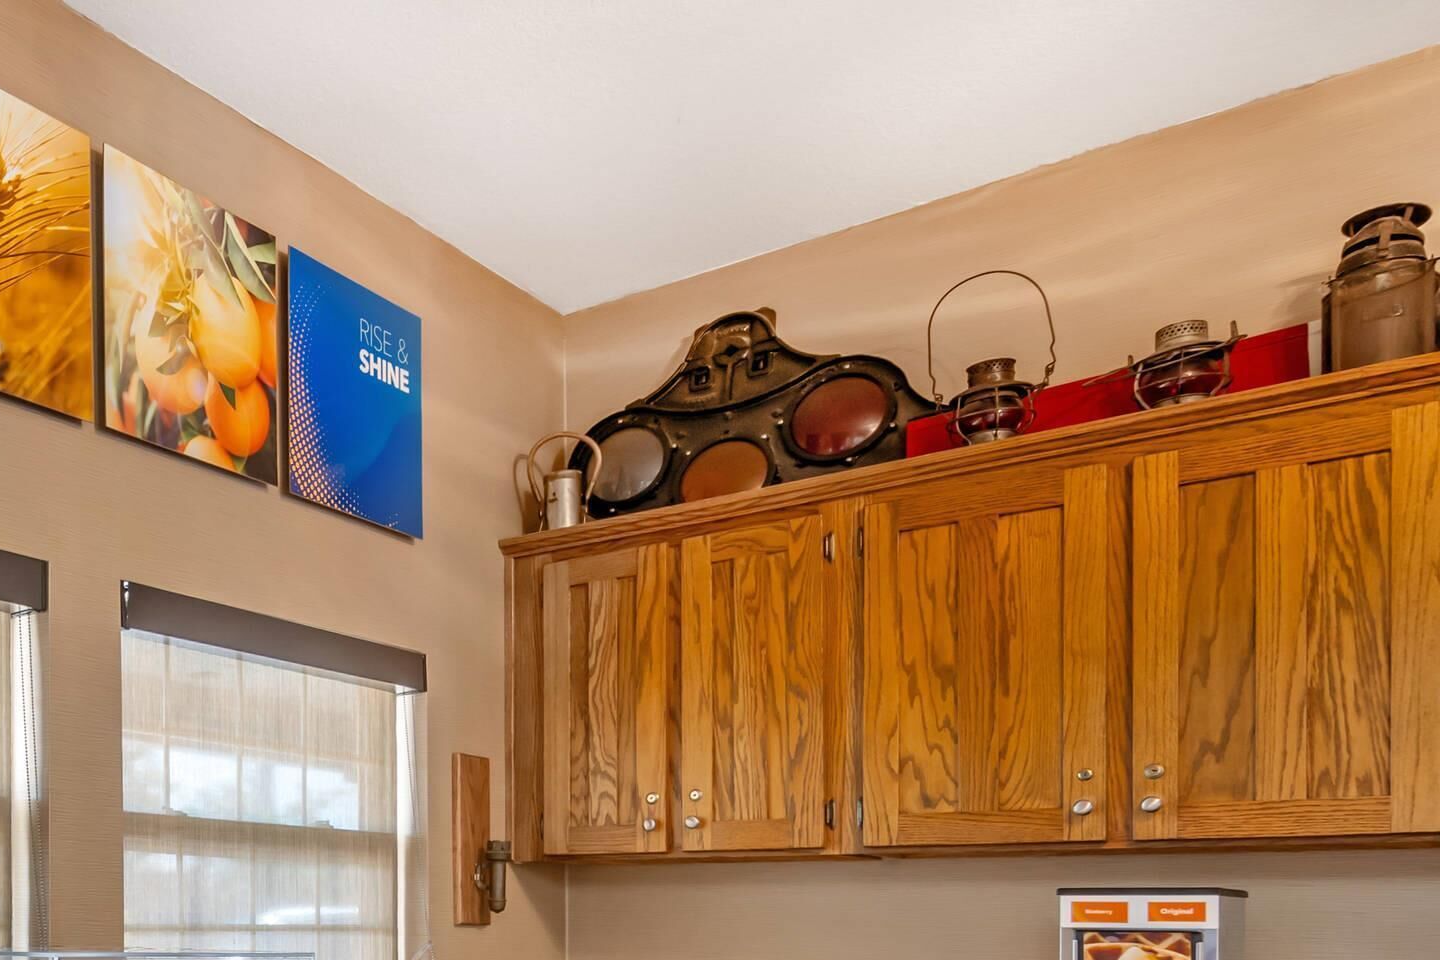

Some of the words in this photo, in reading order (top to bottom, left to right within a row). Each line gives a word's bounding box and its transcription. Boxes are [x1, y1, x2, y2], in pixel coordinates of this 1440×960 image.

[359, 317, 393, 358] RISE
[397, 338, 409, 365] &
[359, 348, 410, 394] SHINE
[1160, 907, 1194, 915] Original
